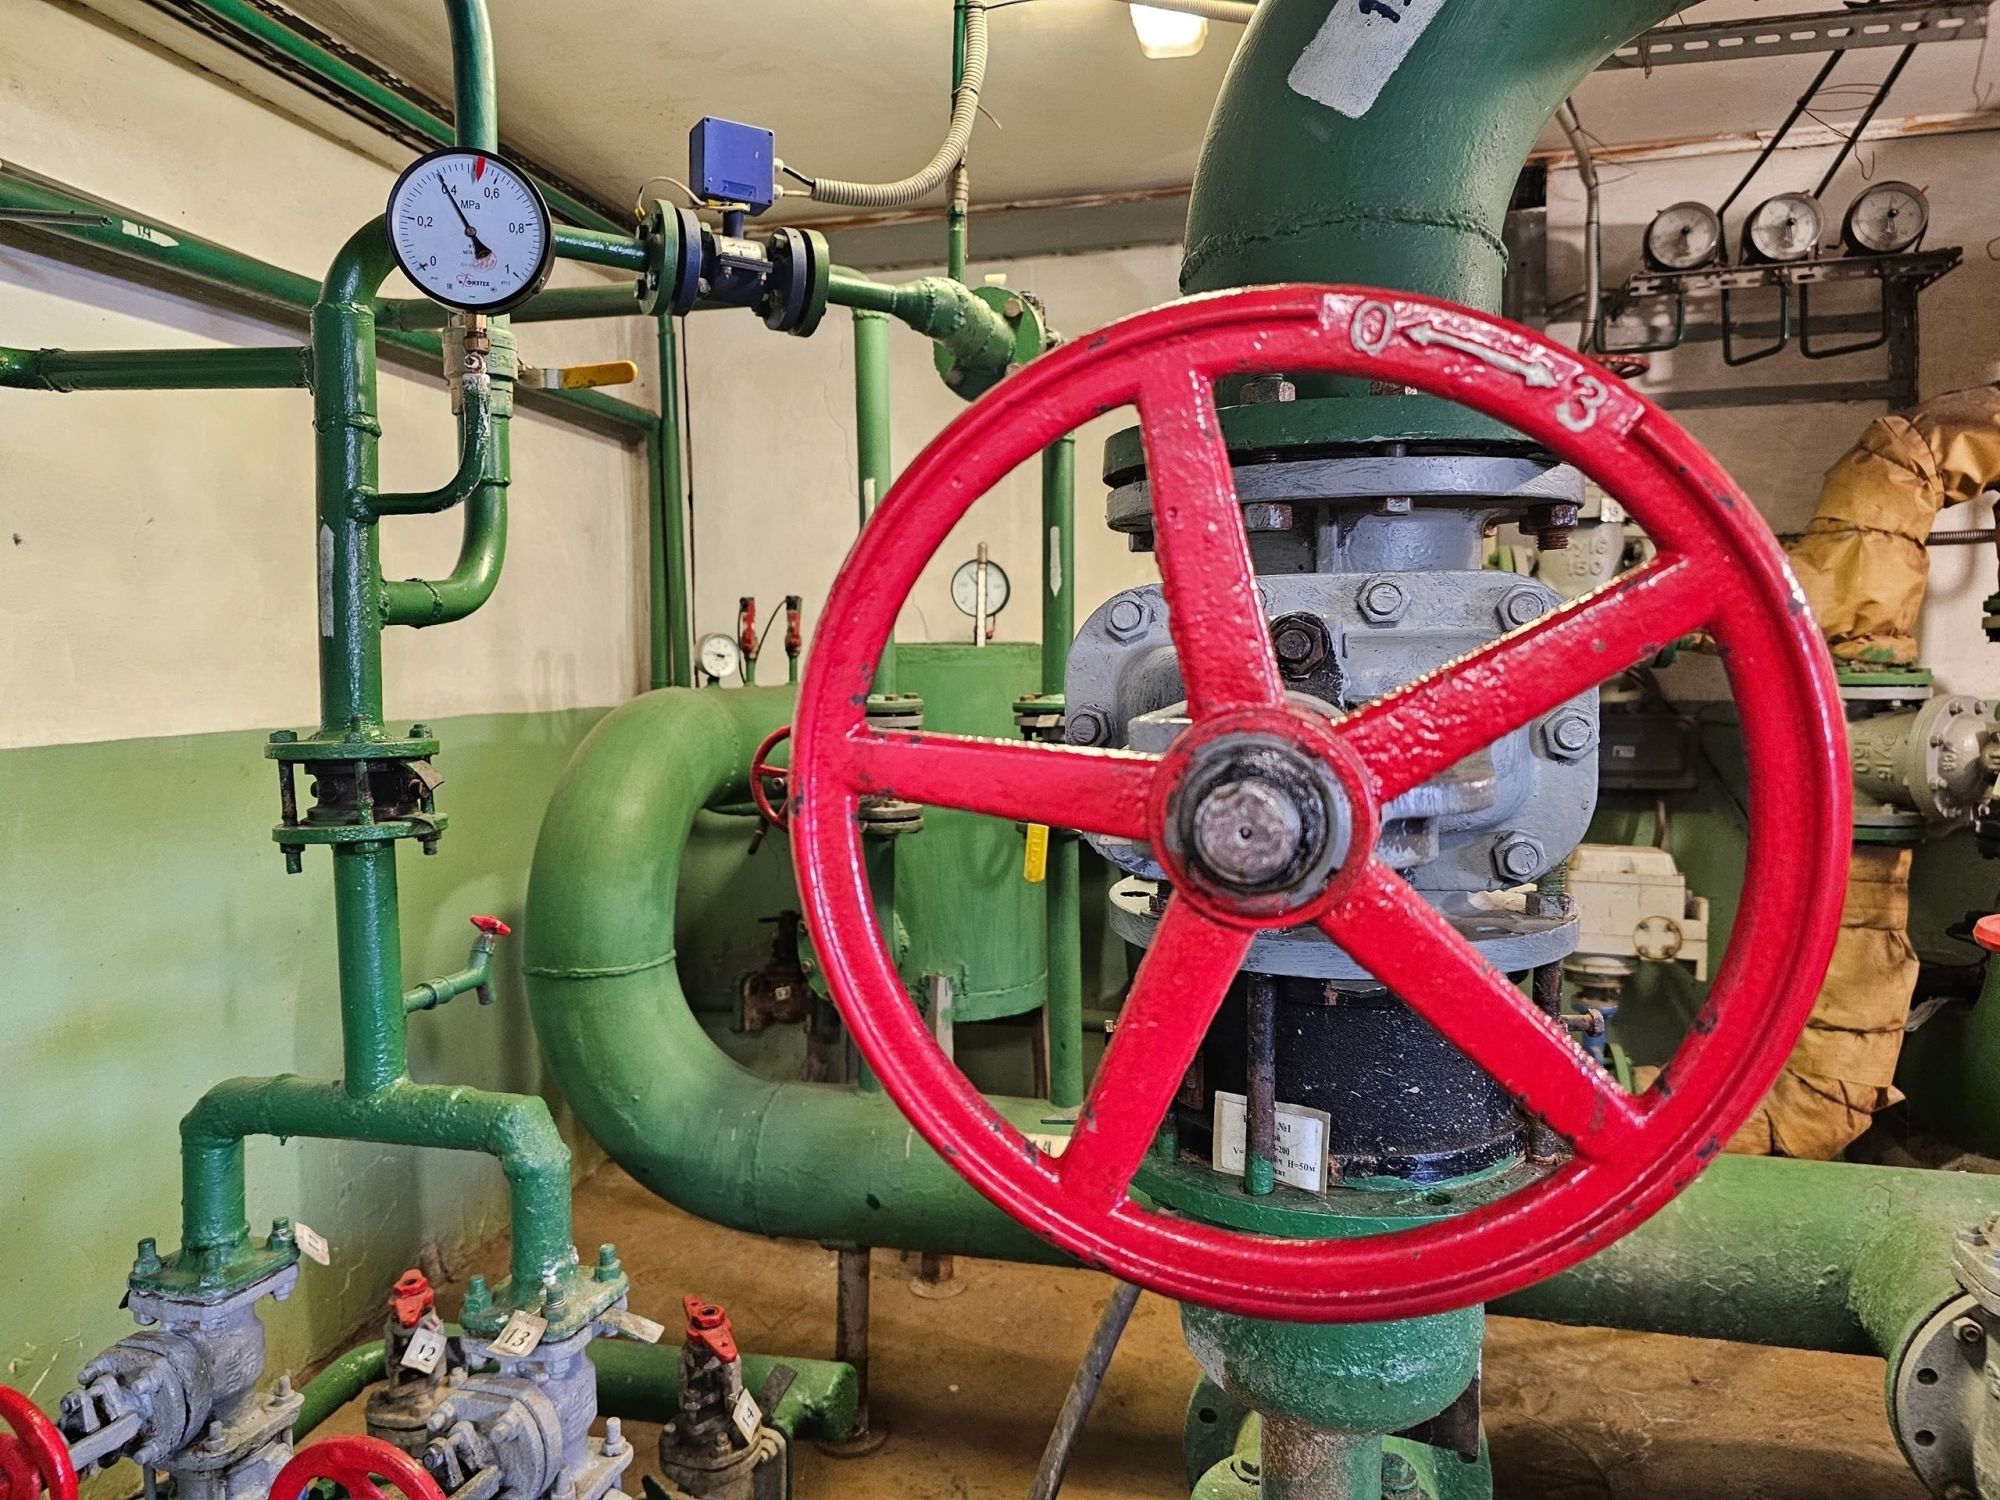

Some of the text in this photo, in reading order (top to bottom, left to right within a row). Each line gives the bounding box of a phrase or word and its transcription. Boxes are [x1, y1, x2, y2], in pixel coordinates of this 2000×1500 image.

[441, 183, 457, 196] 0,4
[484, 187, 500, 200] 0,6
[460, 199, 481, 210] MPa
[417, 216, 433, 228] 0,2
[508, 222, 525, 234] 0,8
[430, 256, 437, 266] 0
[504, 264, 510, 274] 1
[1276, 1122, 1291, 1133] №1
[504, 1327, 531, 1347] 13
[417, 1343, 436, 1362] 12
